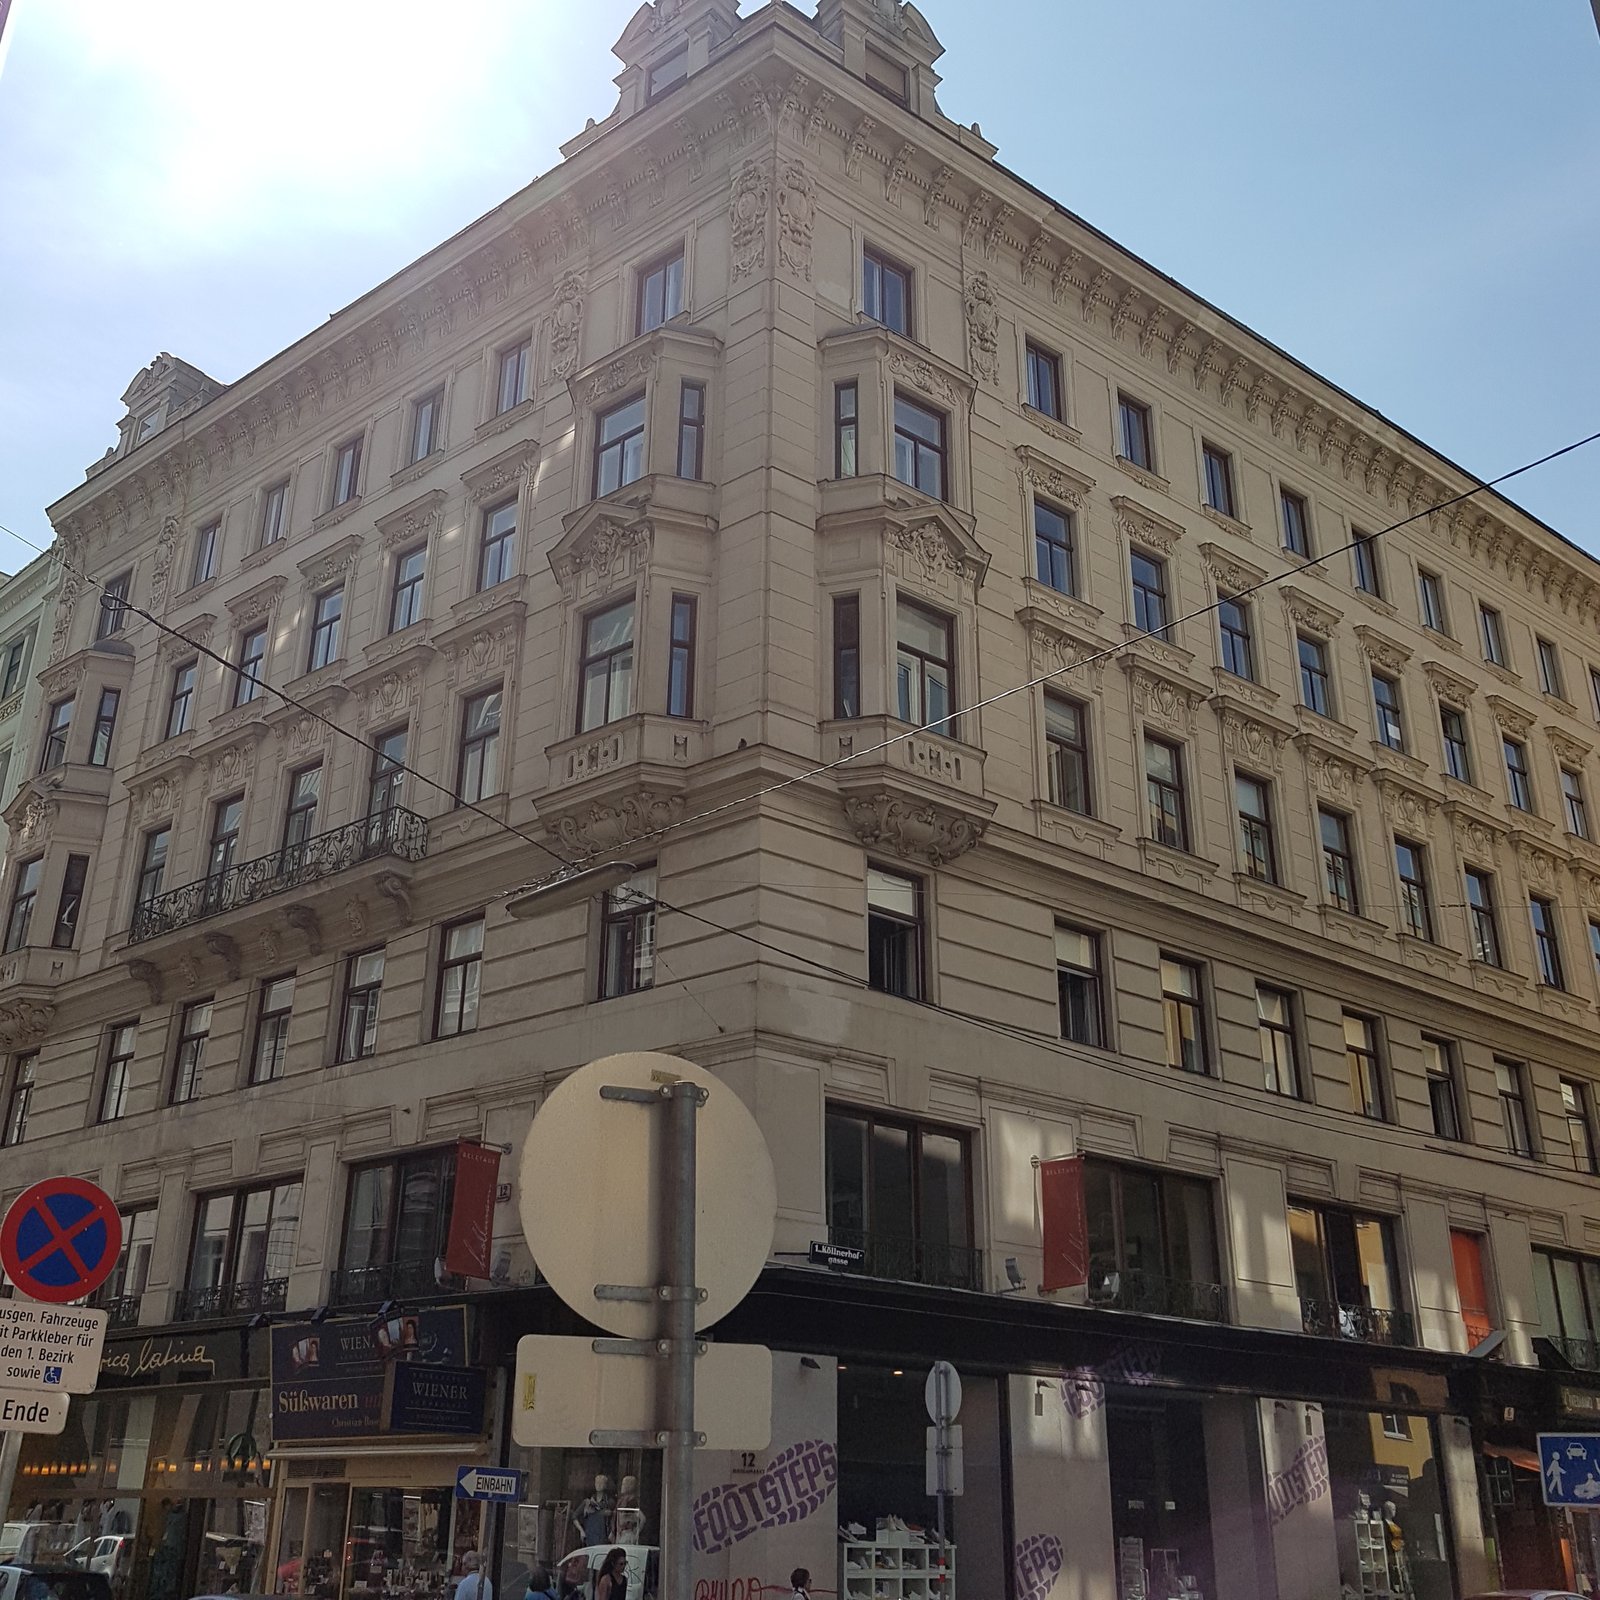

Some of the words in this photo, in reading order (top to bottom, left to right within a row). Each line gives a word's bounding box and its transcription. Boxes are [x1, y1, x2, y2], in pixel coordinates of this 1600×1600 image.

[500, 1186, 508, 1198] 12
[828, 1257, 849, 1265] gasse
[40, 1311, 99, 1331] Fahrzeuge
[12, 1327, 74, 1345] Parkkleber
[76, 1334, 94, 1347] für
[340, 1335, 375, 1351] WIEN
[1, 1345, 22, 1359] den
[27, 1347, 34, 1360] 1.
[39, 1348, 75, 1364] Bezirk
[7, 1365, 41, 1379] sowie
[412, 1382, 468, 1400] WIENER
[2, 1399, 49, 1422] Ende
[278, 1389, 359, 1414] Süßwaren
[741, 1452, 755, 1468] 12
[476, 1476, 513, 1493] EINBAHN
[694, 1443, 838, 1550] FOOTSTEPS
